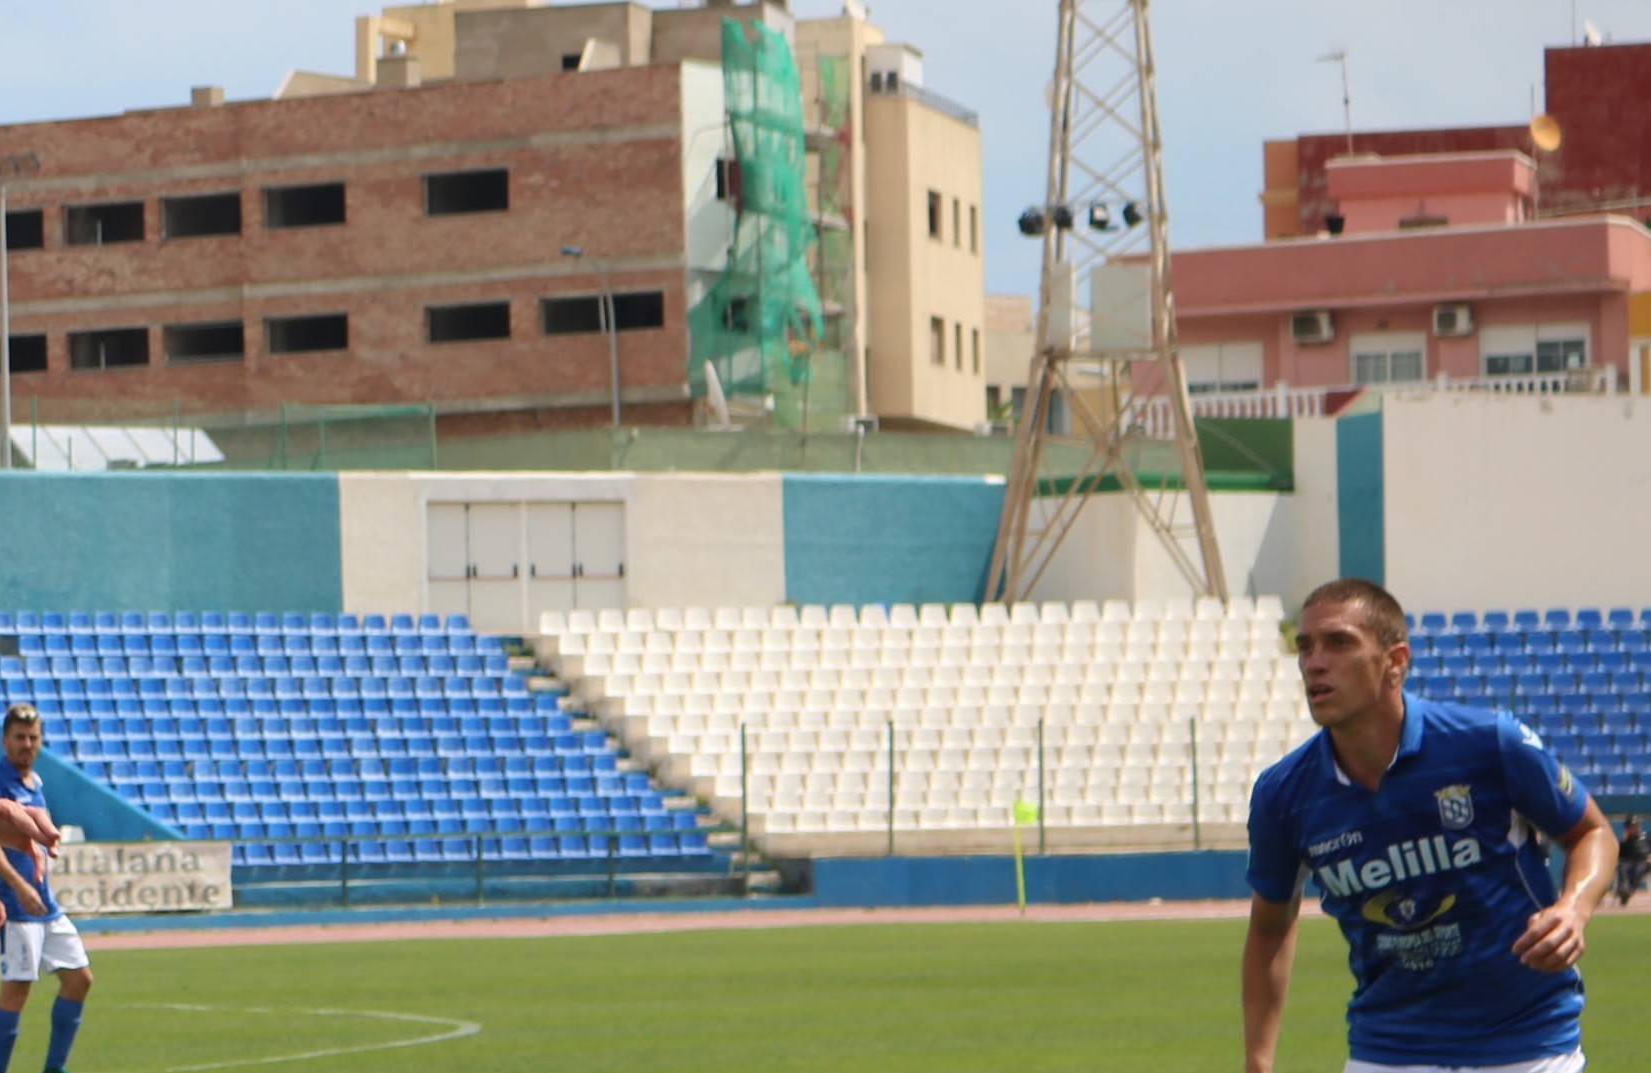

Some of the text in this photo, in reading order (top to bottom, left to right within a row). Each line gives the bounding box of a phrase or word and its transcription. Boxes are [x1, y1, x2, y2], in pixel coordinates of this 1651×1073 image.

[51, 848, 201, 875] atalana
[1319, 835, 1482, 897] Melilla
[55, 880, 220, 908] ccidente
